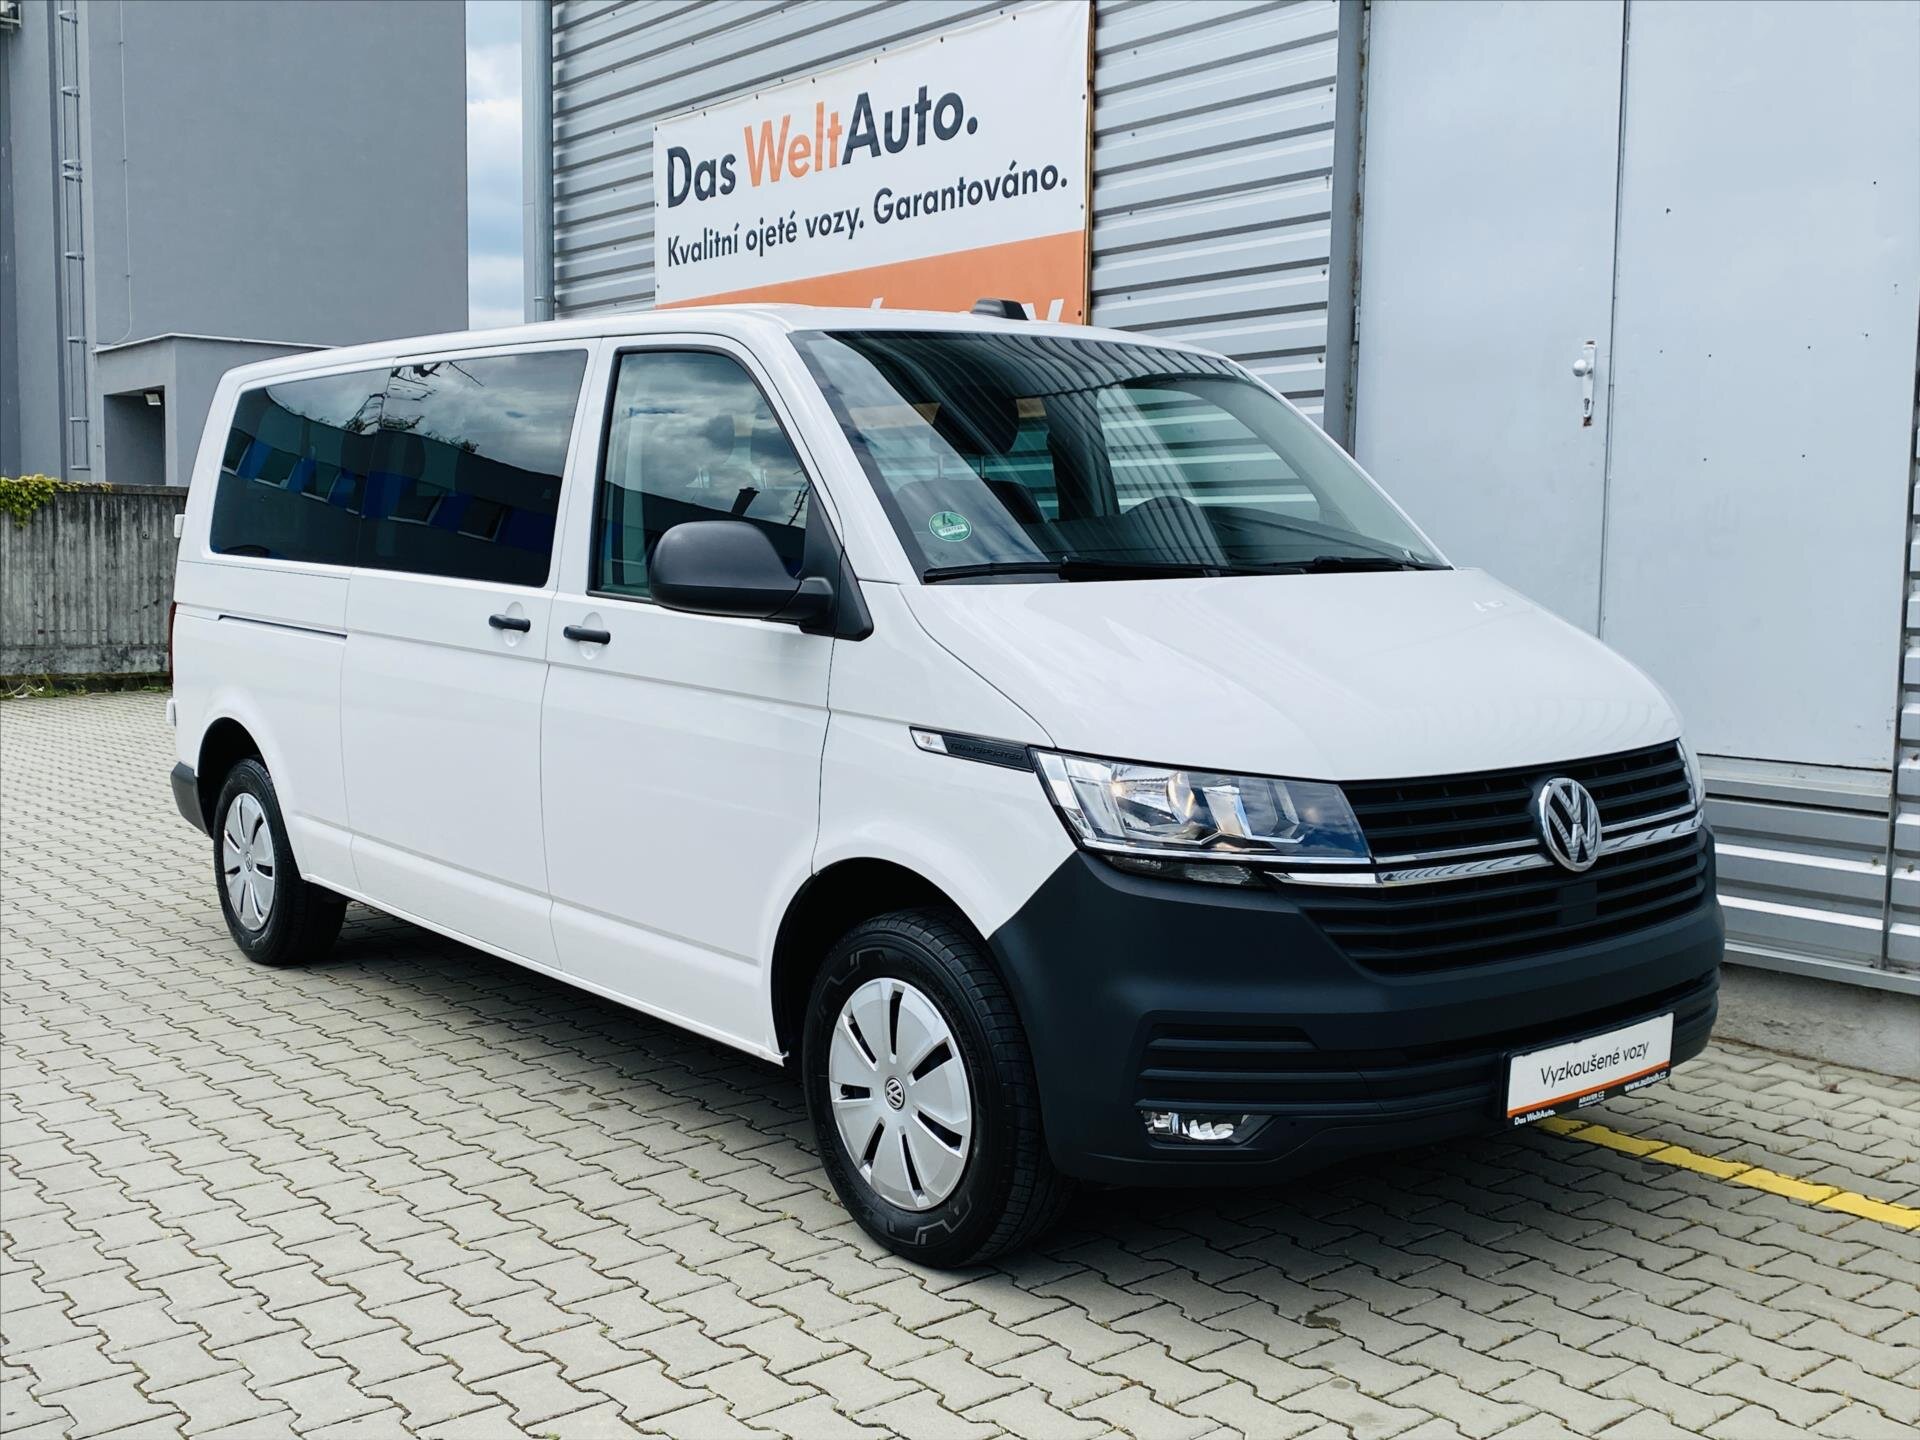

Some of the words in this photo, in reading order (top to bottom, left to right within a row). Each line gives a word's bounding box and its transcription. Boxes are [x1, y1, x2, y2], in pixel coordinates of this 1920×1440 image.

[667, 145, 736, 208] Das
[744, 85, 978, 187] WeltAuto.
[668, 222, 740, 267] Kvalitní
[745, 210, 797, 257] ojeté
[805, 207, 864, 240] vozy.
[873, 160, 1068, 225] Garantováno.
[1540, 1046, 1620, 1088] Vyzkoušené
[1623, 1042, 1649, 1061] vozy
